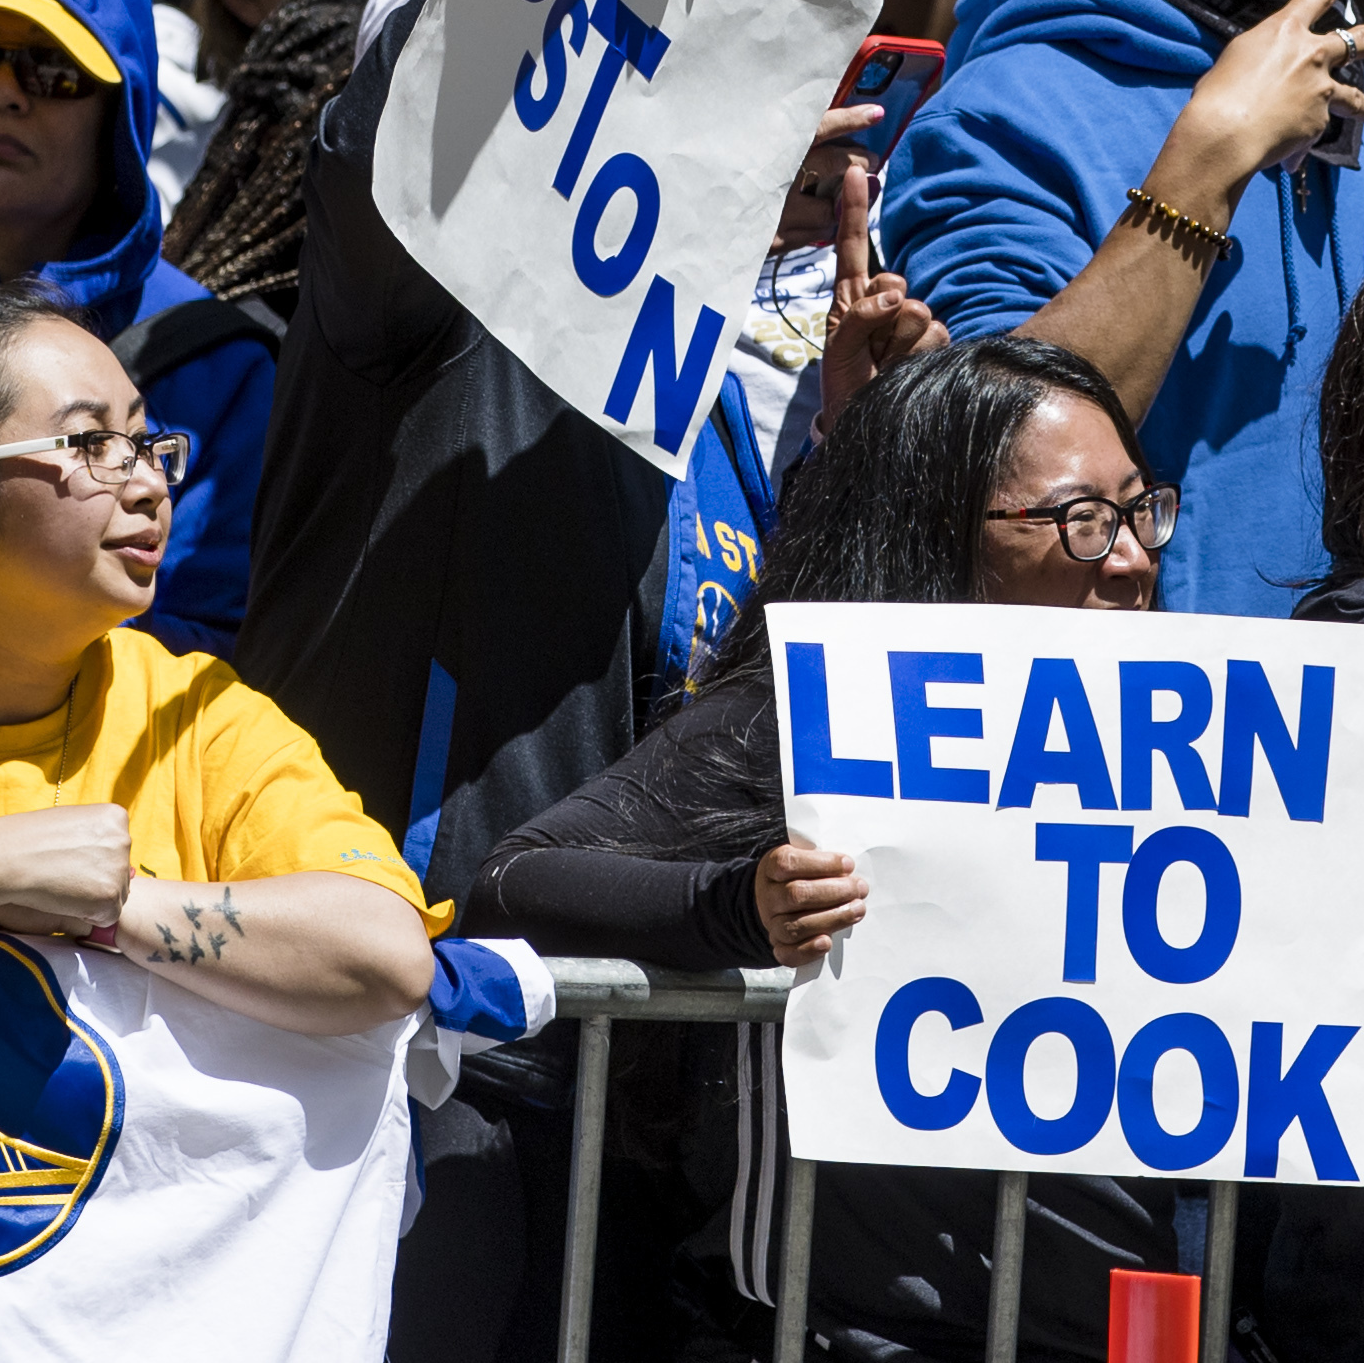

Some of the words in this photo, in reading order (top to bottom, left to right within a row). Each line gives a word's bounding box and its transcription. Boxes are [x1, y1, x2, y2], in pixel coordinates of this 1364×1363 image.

[785, 641, 1336, 824] LEARN
[1035, 822, 1242, 985] TO
[874, 976, 1362, 1183] COOK
